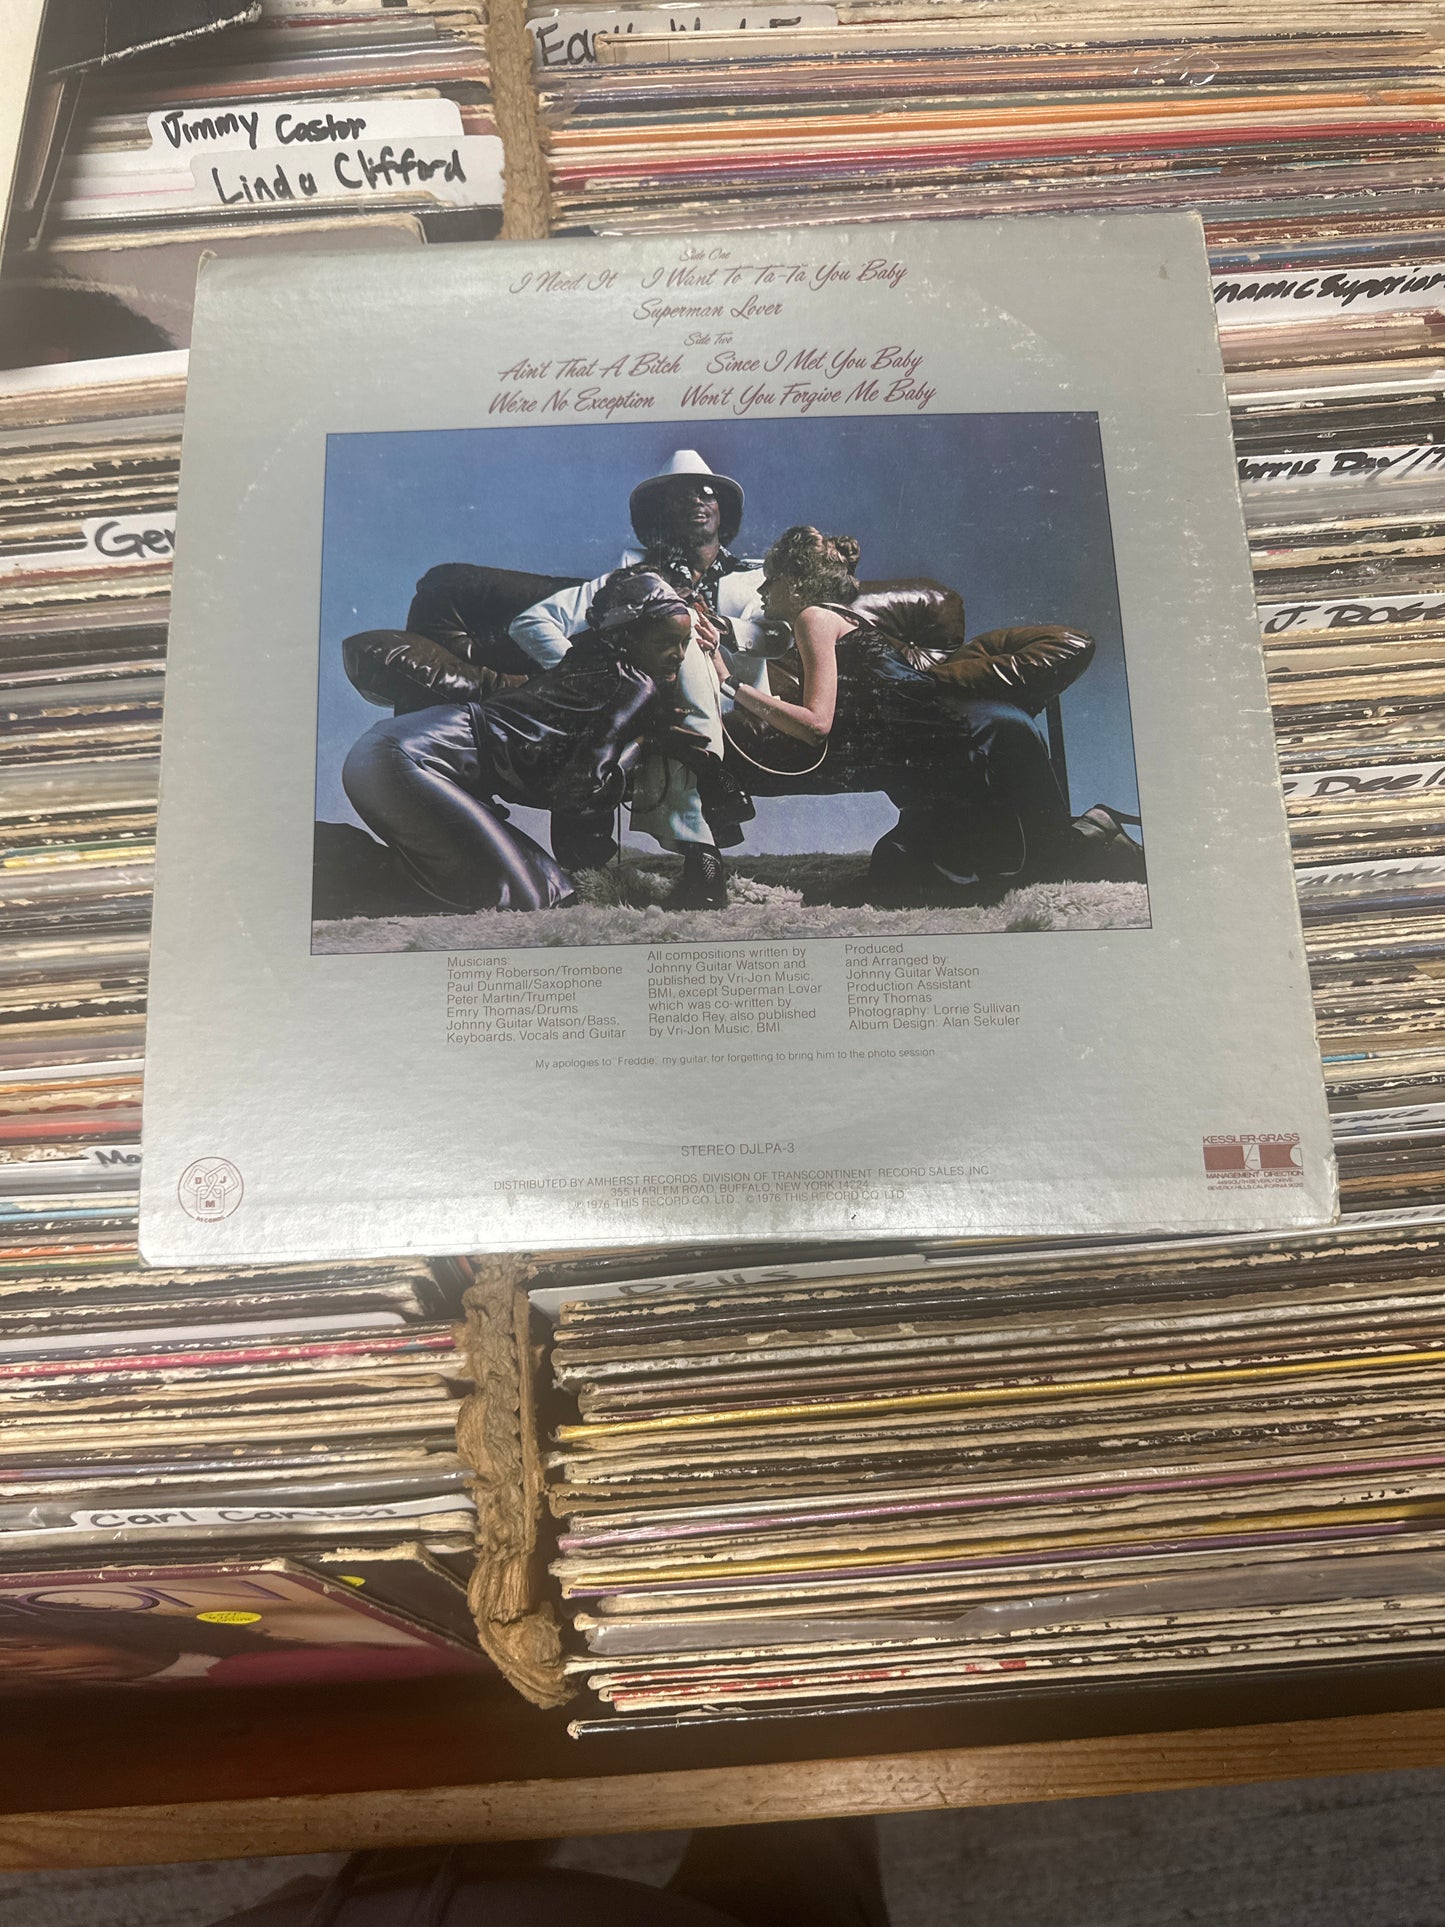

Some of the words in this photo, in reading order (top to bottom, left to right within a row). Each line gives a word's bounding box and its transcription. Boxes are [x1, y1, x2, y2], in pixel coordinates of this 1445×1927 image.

[162, 111, 259, 149] Jimmy
[212, 164, 318, 204] Linda
[334, 146, 468, 190] Clifford
[680, 248, 705, 262] Side
[708, 248, 731, 260] One
[509, 272, 533, 294] I
[536, 271, 587, 293] Need
[587, 269, 619, 291] It
[641, 267, 665, 289] I
[666, 266, 719, 288] Want
[724, 265, 754, 285] To
[809, 261, 851, 291] You
[856, 259, 909, 288] Baby
[633, 298, 724, 327] Superman
[731, 294, 783, 319] Lover
[684, 332, 711, 347] Side
[714, 332, 734, 345] Two
[556, 358, 599, 380] That
[599, 354, 631, 378] A
[628, 352, 684, 376] Bitch
[706, 351, 760, 374] Since
[764, 350, 788, 372] I
[784, 348, 828, 372] Met
[825, 347, 867, 379] You
[871, 346, 924, 377] Baby
[541, 388, 572, 413] No
[574, 387, 656, 419] Exception
[680, 383, 735, 408] Won't
[733, 383, 777, 415] You
[779, 382, 842, 413] Forgive
[844, 379, 879, 404] Me
[883, 378, 937, 410] Baby
[1238, 456, 1321, 484] orris
[647, 951, 662, 961] All
[665, 949, 745, 962] compositions
[749, 947, 788, 958] written
[792, 947, 806, 959] by
[844, 943, 904, 955] Produced
[647, 963, 692, 975] Johnny
[695, 961, 732, 972] Guitar
[736, 960, 780, 971] Watson
[783, 959, 806, 969] and
[845, 957, 868, 967] and
[872, 955, 929, 968] Arranged
[448, 969, 492, 981] Tommy
[496, 965, 623, 978] Roberson/Trombone
[648, 975, 706, 987] published
[709, 974, 723, 986] by
[727, 972, 771, 984] Vri-Jon
[846, 969, 891, 981] Johnny
[895, 967, 931, 978] Guitar
[934, 966, 980, 977] Watson
[447, 982, 474, 992] Paul
[478, 978, 602, 992] Dunmall/Saxophone
[678, 986, 718, 998] except
[721, 985, 784, 997] Superman
[788, 983, 823, 994] Lover
[847, 980, 913, 992] Production
[447, 994, 478, 1005] Peter
[483, 991, 576, 1004] Martin/Trumpet
[649, 1000, 683, 1011] which
[688, 1001, 711, 1010] was
[714, 998, 773, 1009] co-written
[777, 997, 791, 1009] by
[848, 994, 879, 1006] Emry
[883, 992, 933, 1003] Thomas
[447, 1007, 479, 1019] Emry
[484, 1004, 578, 1016] Thomas/Drums
[649, 1013, 698, 1024] Renaldo
[730, 1010, 754, 1021] also
[758, 1008, 816, 1021] published
[933, 1004, 970, 1015] Lorrie
[973, 1003, 1021, 1014] Sullivan
[446, 1019, 492, 1032] Johnny
[496, 1018, 533, 1029] Guitar
[849, 1019, 889, 1030] Album
[943, 1017, 970, 1027] Alan
[973, 1015, 1021, 1026] Sekuler
[519, 1030, 558, 1041] Vocals
[562, 1029, 584, 1039] and
[589, 1028, 626, 1039] Guitar
[649, 1026, 663, 1038] by
[667, 1025, 710, 1036] Vri-Jon
[535, 1060, 549, 1070] My
[553, 1058, 600, 1069] apologies
[602, 1058, 611, 1067] to
[662, 1056, 677, 1065] my
[711, 1054, 724, 1062] for
[727, 1053, 773, 1063] forgetting
[776, 1053, 786, 1061] to
[788, 1052, 813, 1062] bring
[816, 1051, 834, 1059] him
[837, 1051, 847, 1059] to
[849, 1050, 865, 1058] the
[867, 1049, 896, 1059] photo
[1203, 1132, 1300, 1143] KESSLER-GRASS
[681, 1144, 735, 1157] STEREO
[739, 1142, 795, 1155] DJLPA-3
[494, 1178, 568, 1191] DISTRIBUTED
[570, 1177, 584, 1188] BY
[587, 1175, 640, 1187] AMHERST
[702, 1172, 750, 1183] DIVISION
[753, 1171, 768, 1181] OF
[771, 1169, 872, 1181] TRANSCONTINENT
[878, 1167, 926, 1177] RECORD
[1206, 1171, 1259, 1179] MANAGEMENT
[611, 1187, 630, 1197] 355
[632, 1186, 679, 1196] HARLEM
[775, 1181, 800, 1191] NEW
[804, 1180, 835, 1190] YORK
[586, 1199, 610, 1209] 1976
[614, 1197, 639, 1208] THIS
[642, 1196, 689, 1206] RECORD
[757, 1193, 781, 1203] 1976
[784, 1192, 808, 1202] THIS
[89, 1510, 198, 1529] Carl
